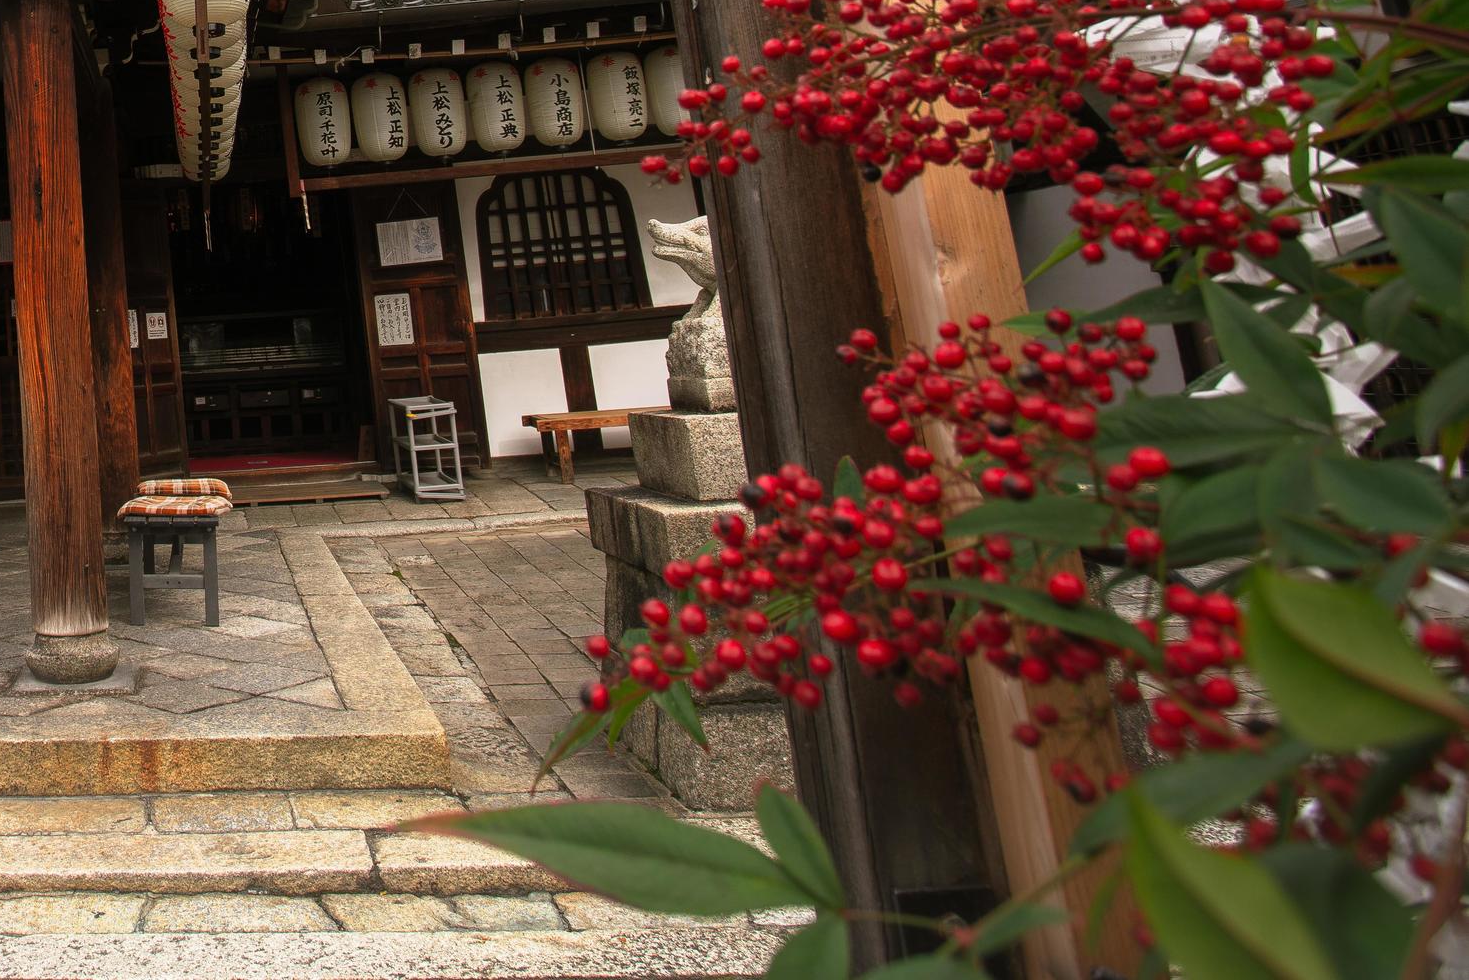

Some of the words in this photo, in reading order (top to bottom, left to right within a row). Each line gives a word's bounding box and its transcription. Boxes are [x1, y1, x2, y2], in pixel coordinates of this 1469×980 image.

[386, 86, 404, 148] 上松正知
[432, 80, 454, 149] 上松みどり
[496, 75, 519, 138] 上松正典
[550, 73, 574, 137] 小島商店
[622, 66, 644, 128] 飯塚亮二
